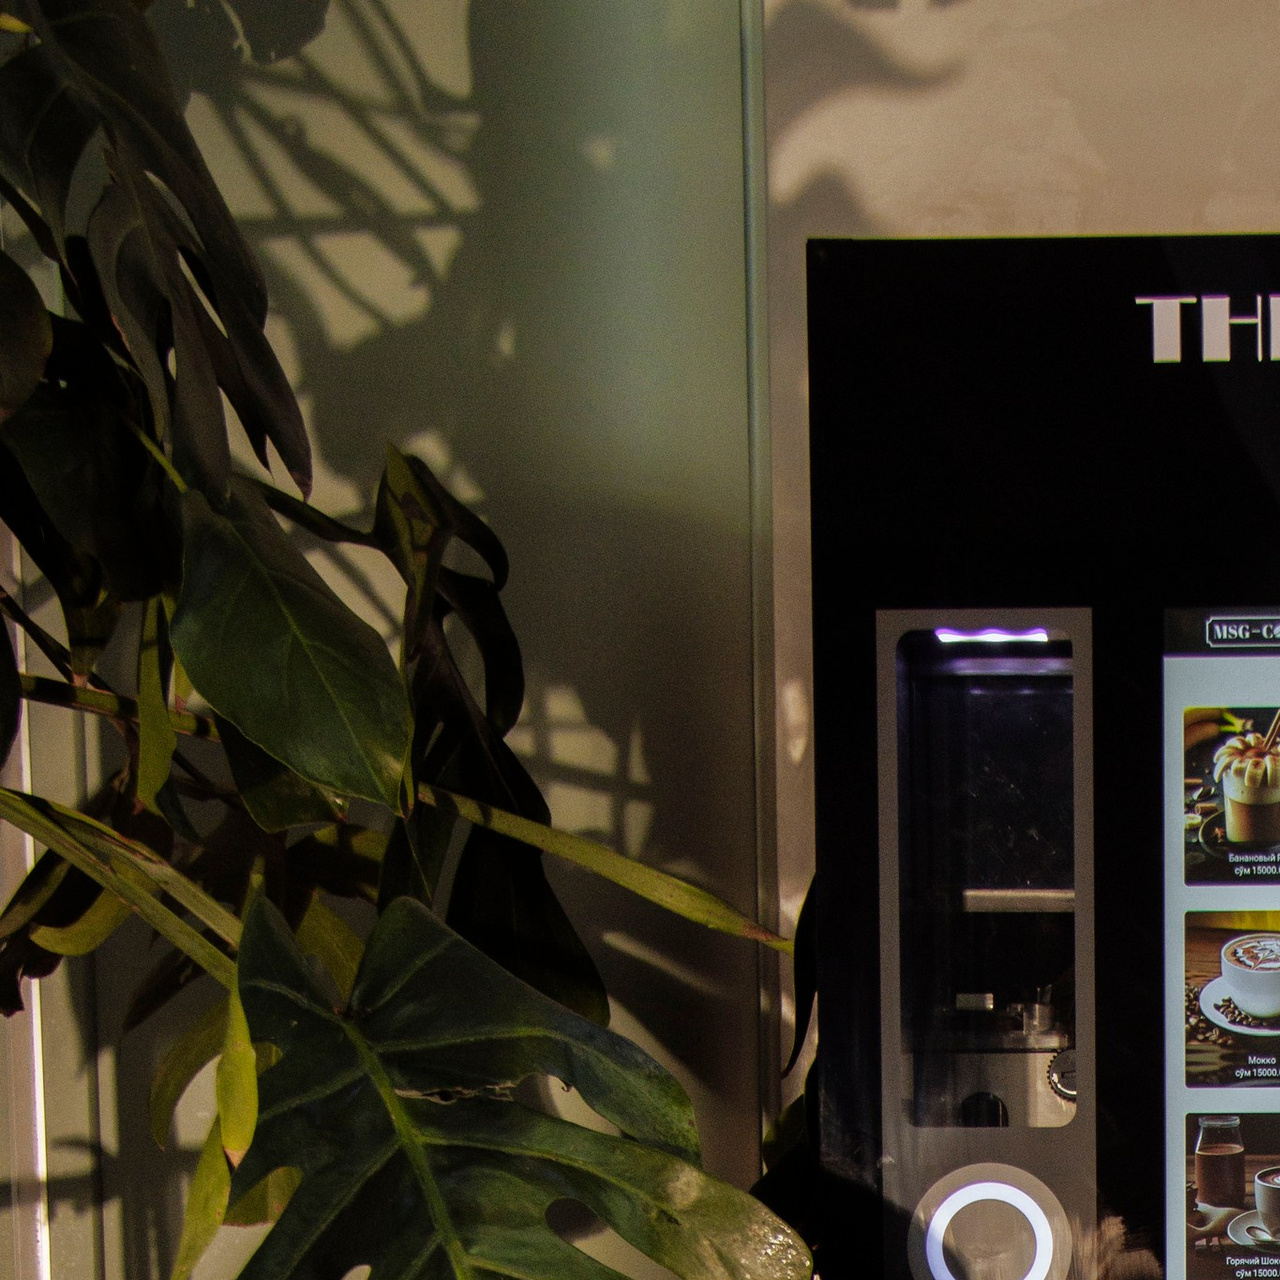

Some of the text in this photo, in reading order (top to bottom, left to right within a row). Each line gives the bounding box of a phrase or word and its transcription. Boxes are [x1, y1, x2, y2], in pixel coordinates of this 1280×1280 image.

[1229, 853, 1275, 862] Банановый
[1248, 1056, 1276, 1065] Мокко
[1226, 1257, 1259, 1266] Горячий
